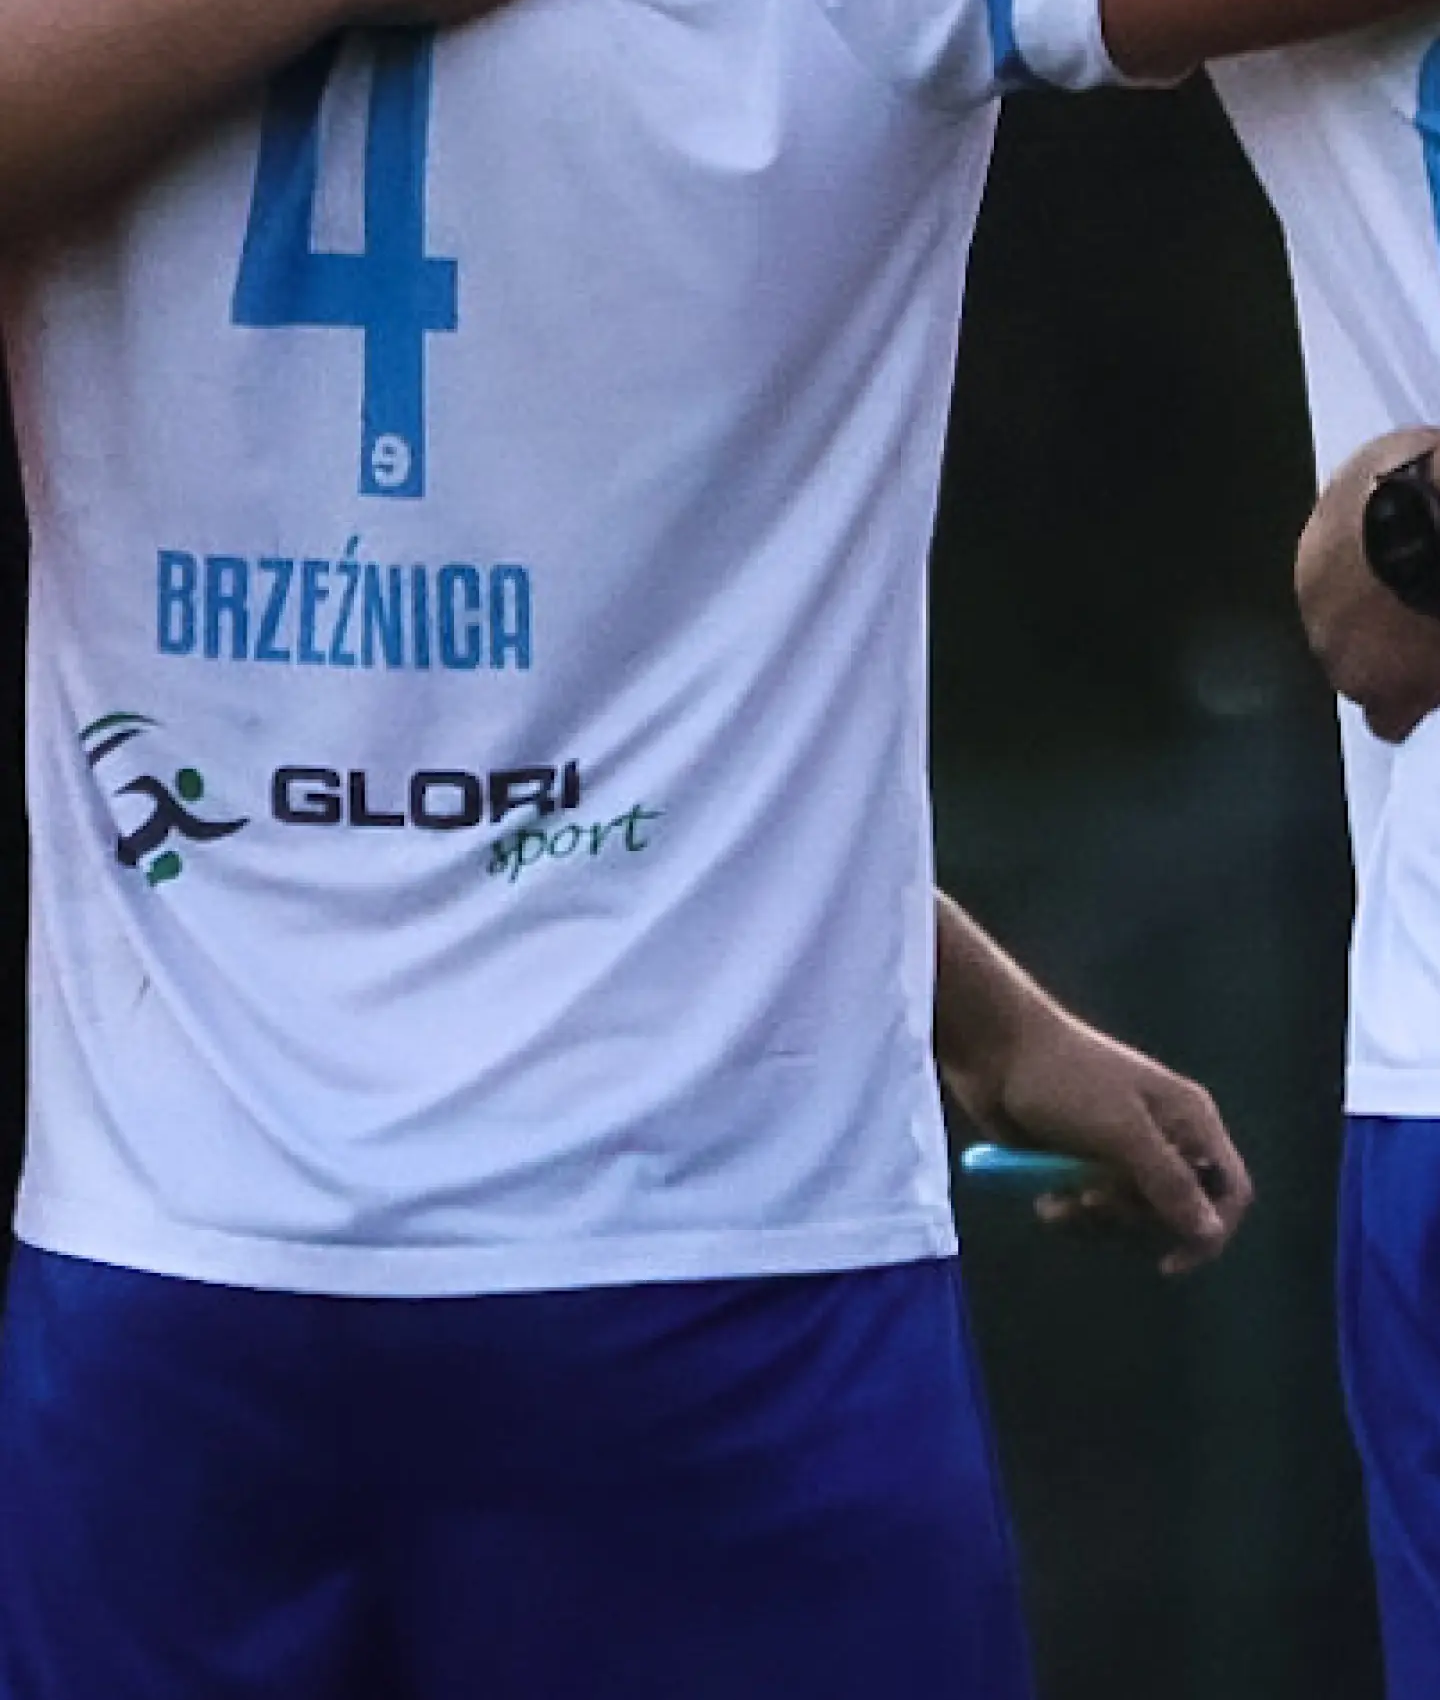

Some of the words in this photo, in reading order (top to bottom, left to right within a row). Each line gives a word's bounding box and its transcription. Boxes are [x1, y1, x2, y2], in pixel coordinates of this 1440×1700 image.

[231, 22, 459, 498] 4
[156, 534, 533, 672] BRZEŹNICA
[271, 757, 582, 831] GLORI
[487, 802, 666, 884] sport
